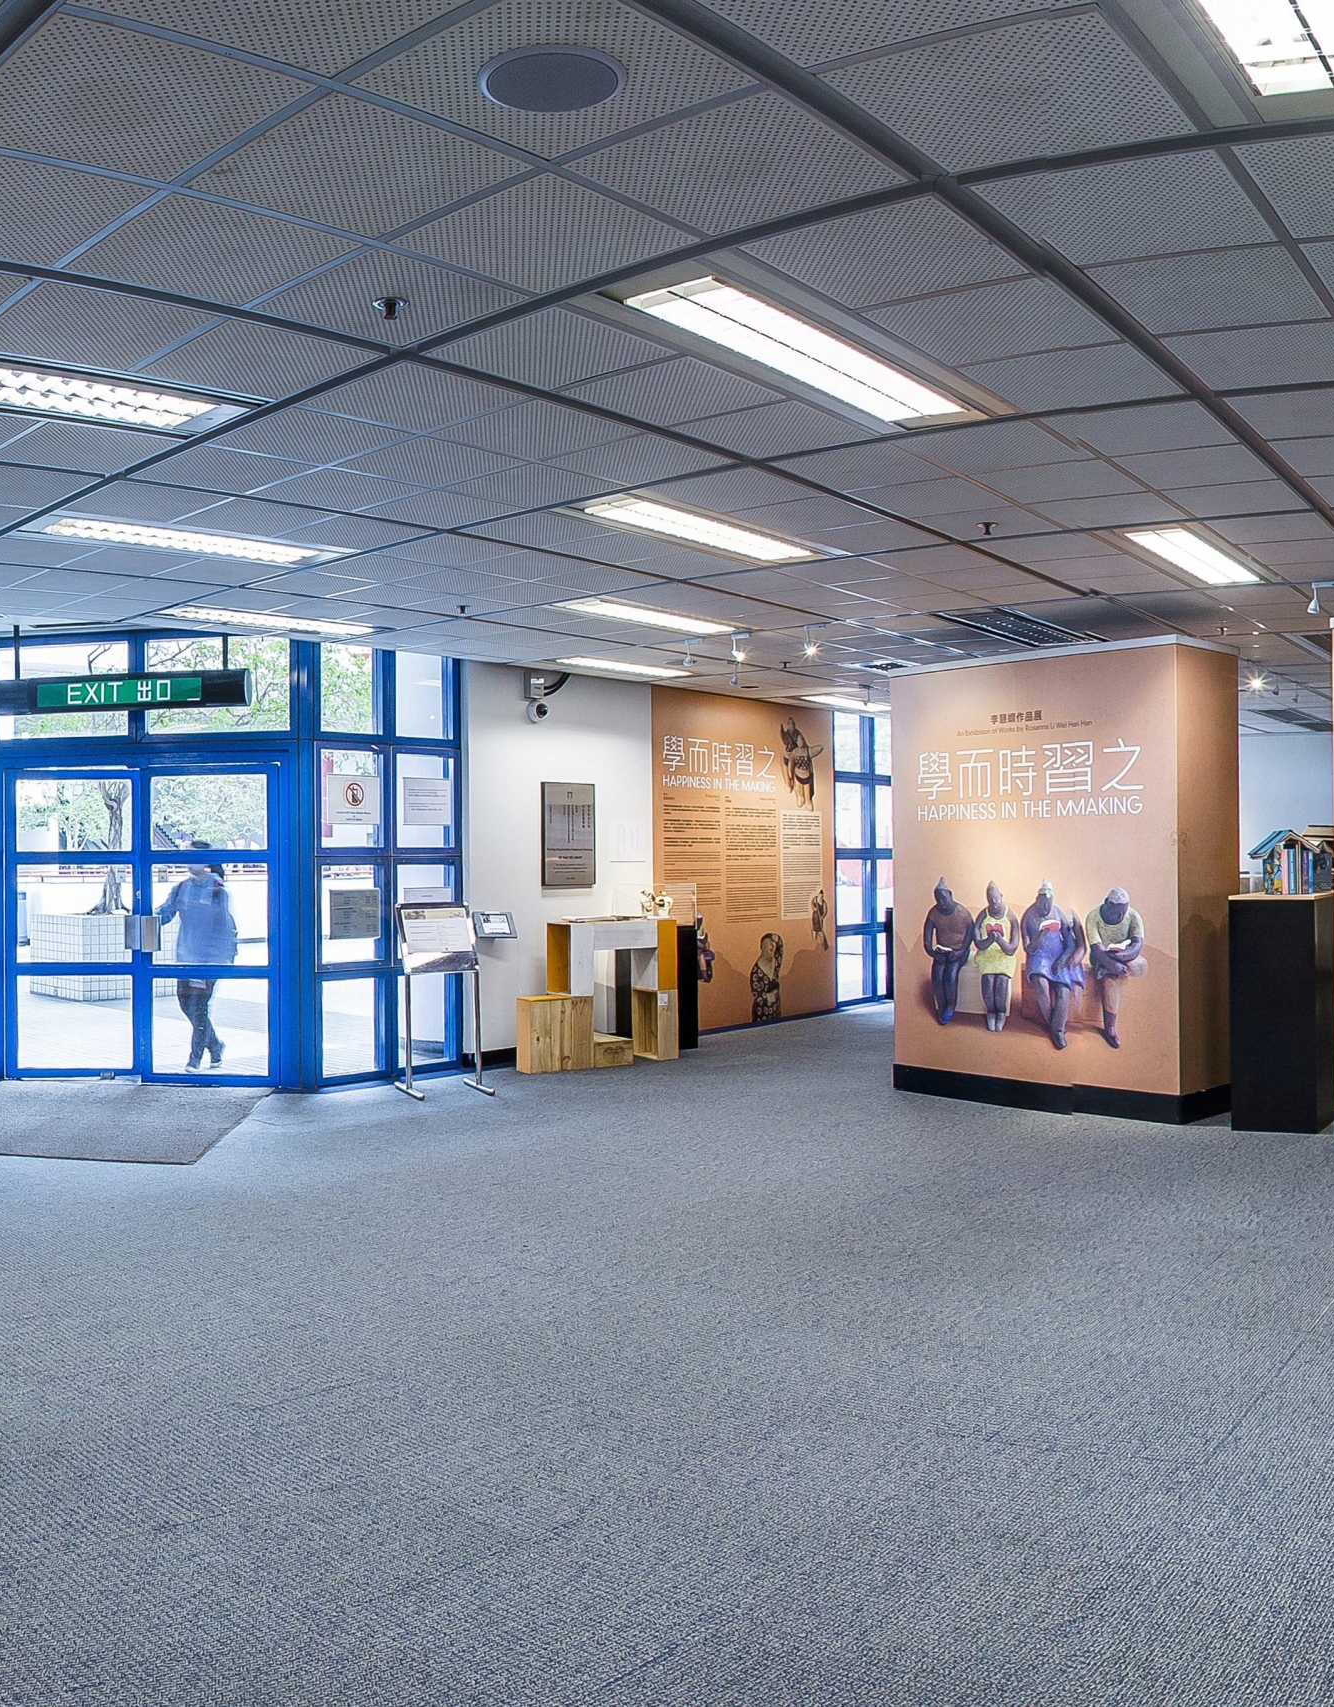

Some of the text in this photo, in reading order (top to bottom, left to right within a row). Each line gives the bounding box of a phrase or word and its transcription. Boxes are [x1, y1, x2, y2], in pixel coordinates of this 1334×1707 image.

[67, 680, 171, 705] EXIT 出口
[957, 730, 964, 738] An
[965, 728, 991, 737] Exhibition
[992, 727, 998, 735] of
[999, 725, 1015, 734] Works
[1016, 725, 1024, 734] by
[1056, 721, 1067, 729] Wei
[1080, 719, 1093, 727] Han
[662, 735, 777, 779] 學而時習之
[916, 737, 1145, 801] 學而時習之
[662, 774, 776, 794] HAPPINESS IN THE MAKING
[917, 801, 997, 822] HAPPINESS
[1001, 801, 1017, 819] IN
[1022, 799, 1052, 818] THE
